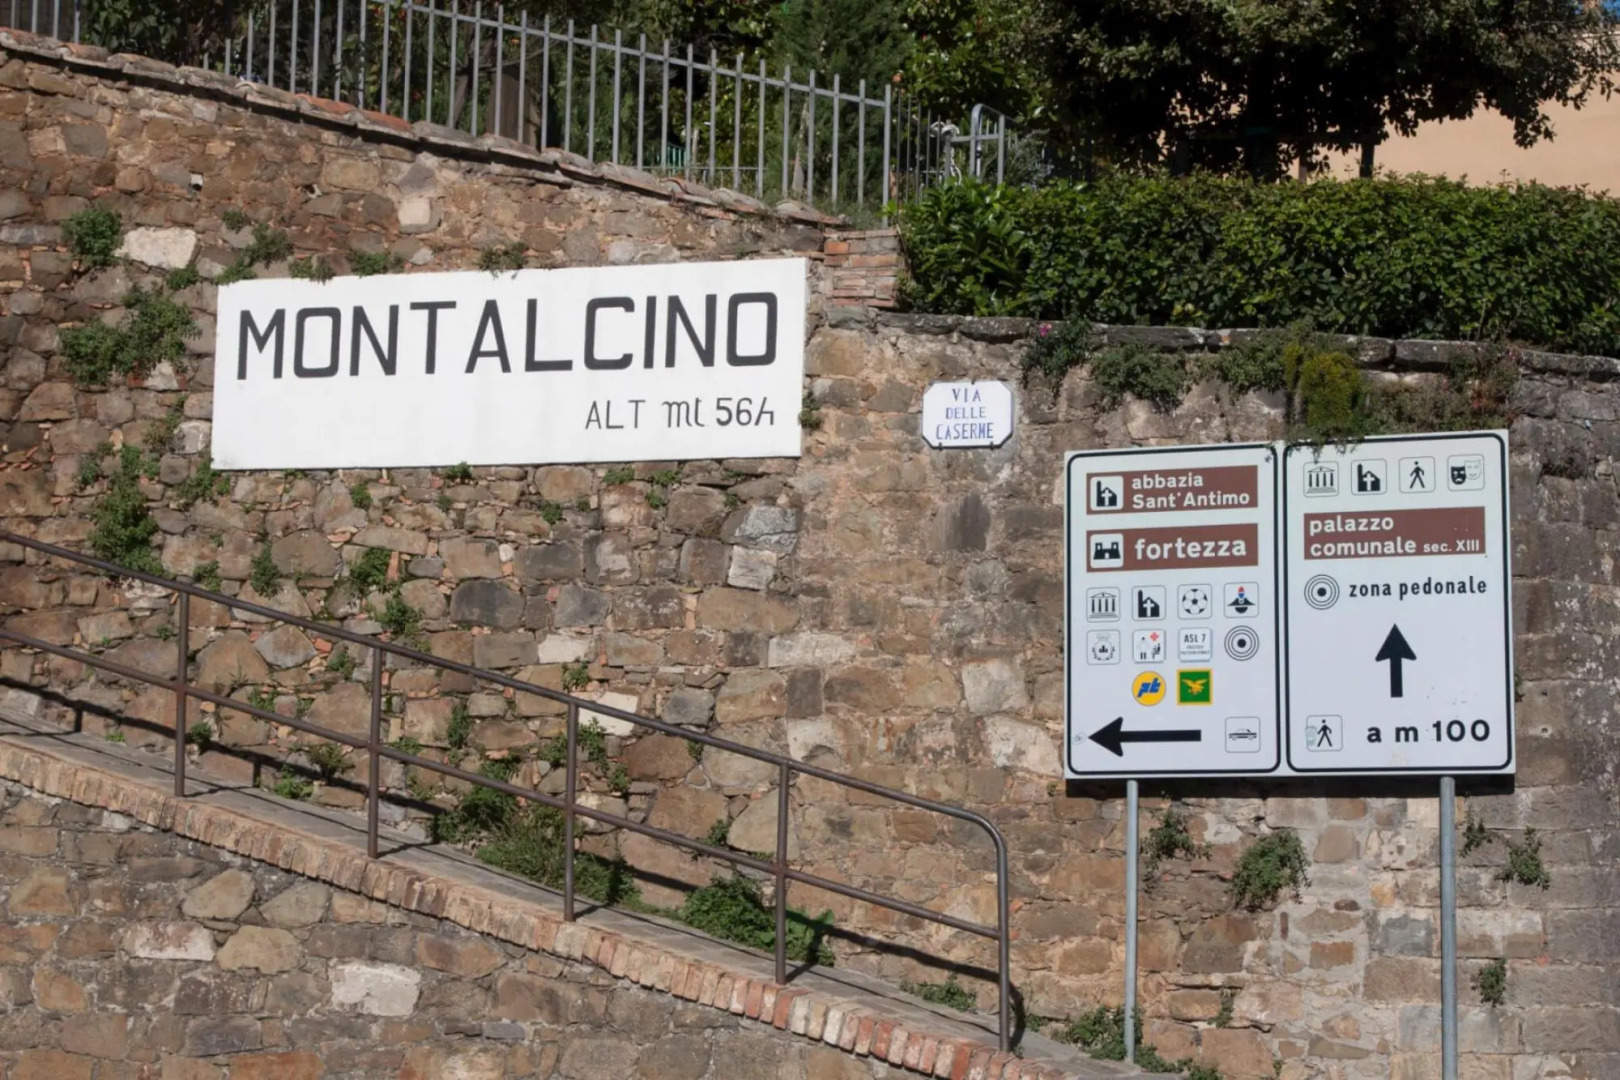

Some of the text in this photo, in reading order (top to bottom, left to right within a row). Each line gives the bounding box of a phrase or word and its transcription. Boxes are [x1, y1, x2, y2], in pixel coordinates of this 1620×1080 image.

[237, 292, 777, 380] MONTALCINO
[952, 388, 981, 402] VIA
[585, 399, 646, 429] ALT
[716, 396, 774, 426] 564
[946, 406, 986, 419] DELLE
[936, 422, 994, 440] CASERME
[1132, 473, 1203, 489] abbazia
[1310, 515, 1394, 536] palazzo
[1135, 537, 1247, 560] fortezza
[1310, 537, 1480, 556] comunale sec. XIII
[1349, 576, 1487, 601] zona pedonale
[1184, 633, 1206, 643] ASL 7
[1367, 719, 1490, 743] a m 100
